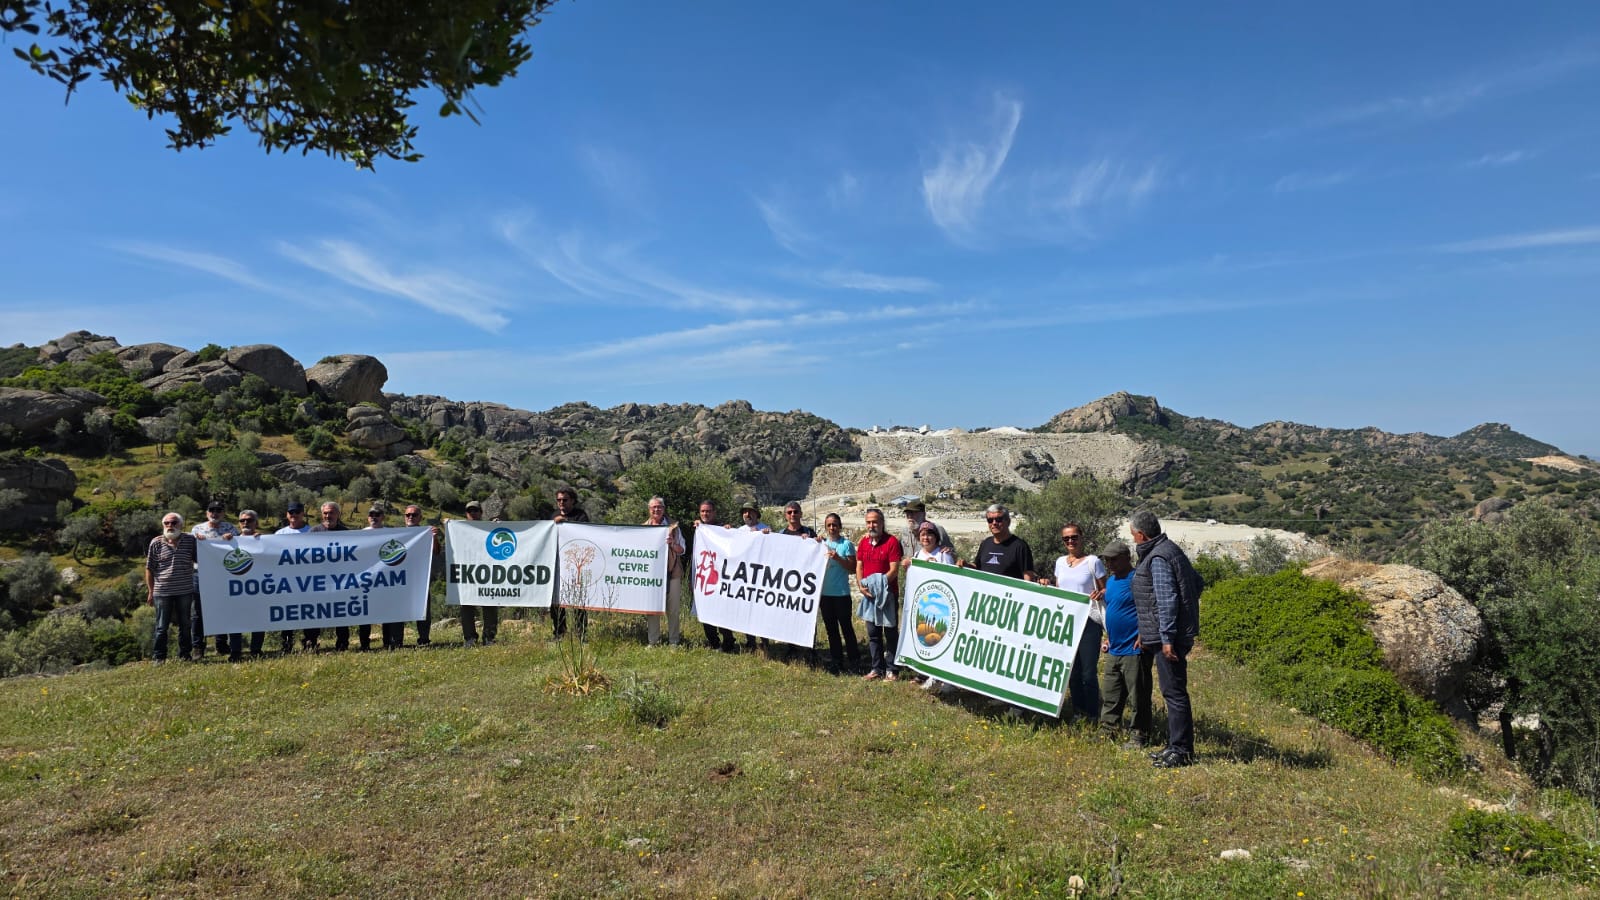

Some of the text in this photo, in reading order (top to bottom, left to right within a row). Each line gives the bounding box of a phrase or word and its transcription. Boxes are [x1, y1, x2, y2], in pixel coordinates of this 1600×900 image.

[278, 542, 358, 566] AKBÜK
[611, 548, 659, 560] KUŞADASI
[450, 564, 551, 586] EKODOSD
[618, 562, 650, 573] ÇEVRE
[721, 558, 817, 595] LATMOS
[229, 570, 407, 596] DOĞA VE YAŞAM
[478, 587, 521, 599] KUŞADASI
[604, 576, 663, 588] PLATFORMU
[270, 595, 369, 622] DERNEĞİ
[720, 582, 814, 614] PLATFORMU
[964, 592, 1024, 632] AKBÜK
[1023, 604, 1075, 646] DOĞA
[953, 630, 1072, 694] GÖNÜLLÜLERİ
